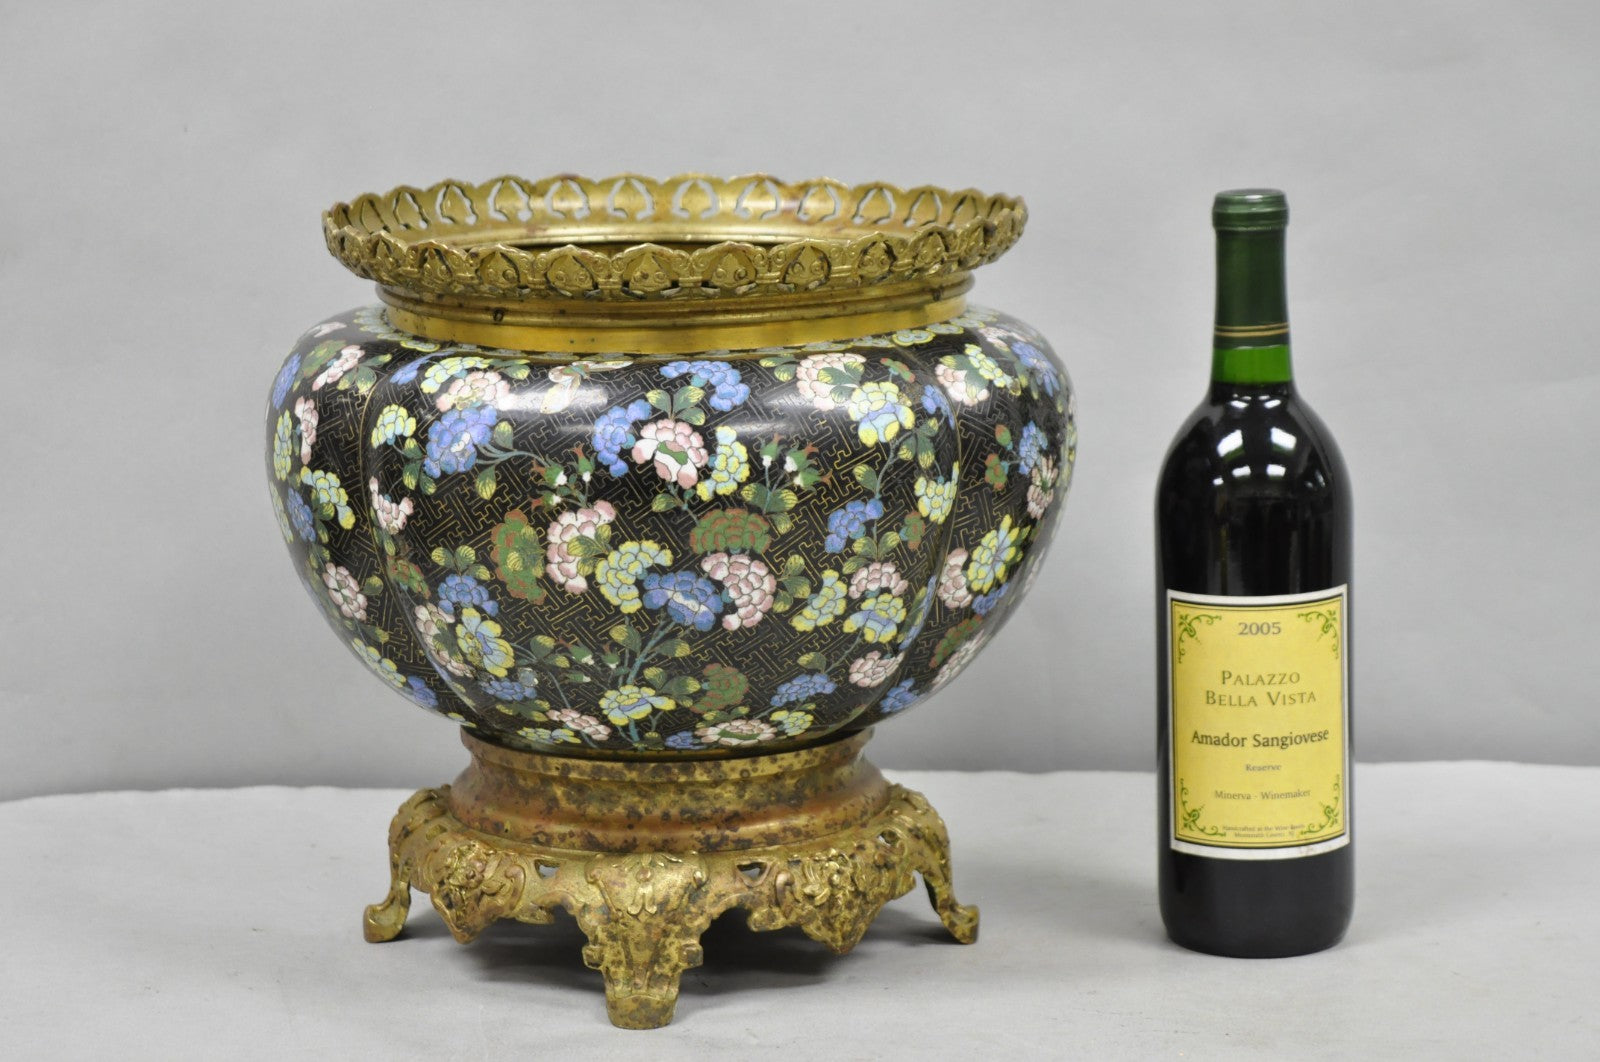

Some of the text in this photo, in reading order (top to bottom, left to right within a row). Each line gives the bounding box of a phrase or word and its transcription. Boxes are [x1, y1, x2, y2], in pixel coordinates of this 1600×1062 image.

[1238, 622, 1282, 635] 2005
[1221, 670, 1301, 686] PALAZZO
[1205, 690, 1317, 707] BELLA VISTA
[1192, 729, 1329, 749] Amador Sangiovese
[1246, 764, 1282, 772] Reserve
[1215, 790, 1251, 800] Minerva
[1261, 789, 1311, 800] Winemaker
